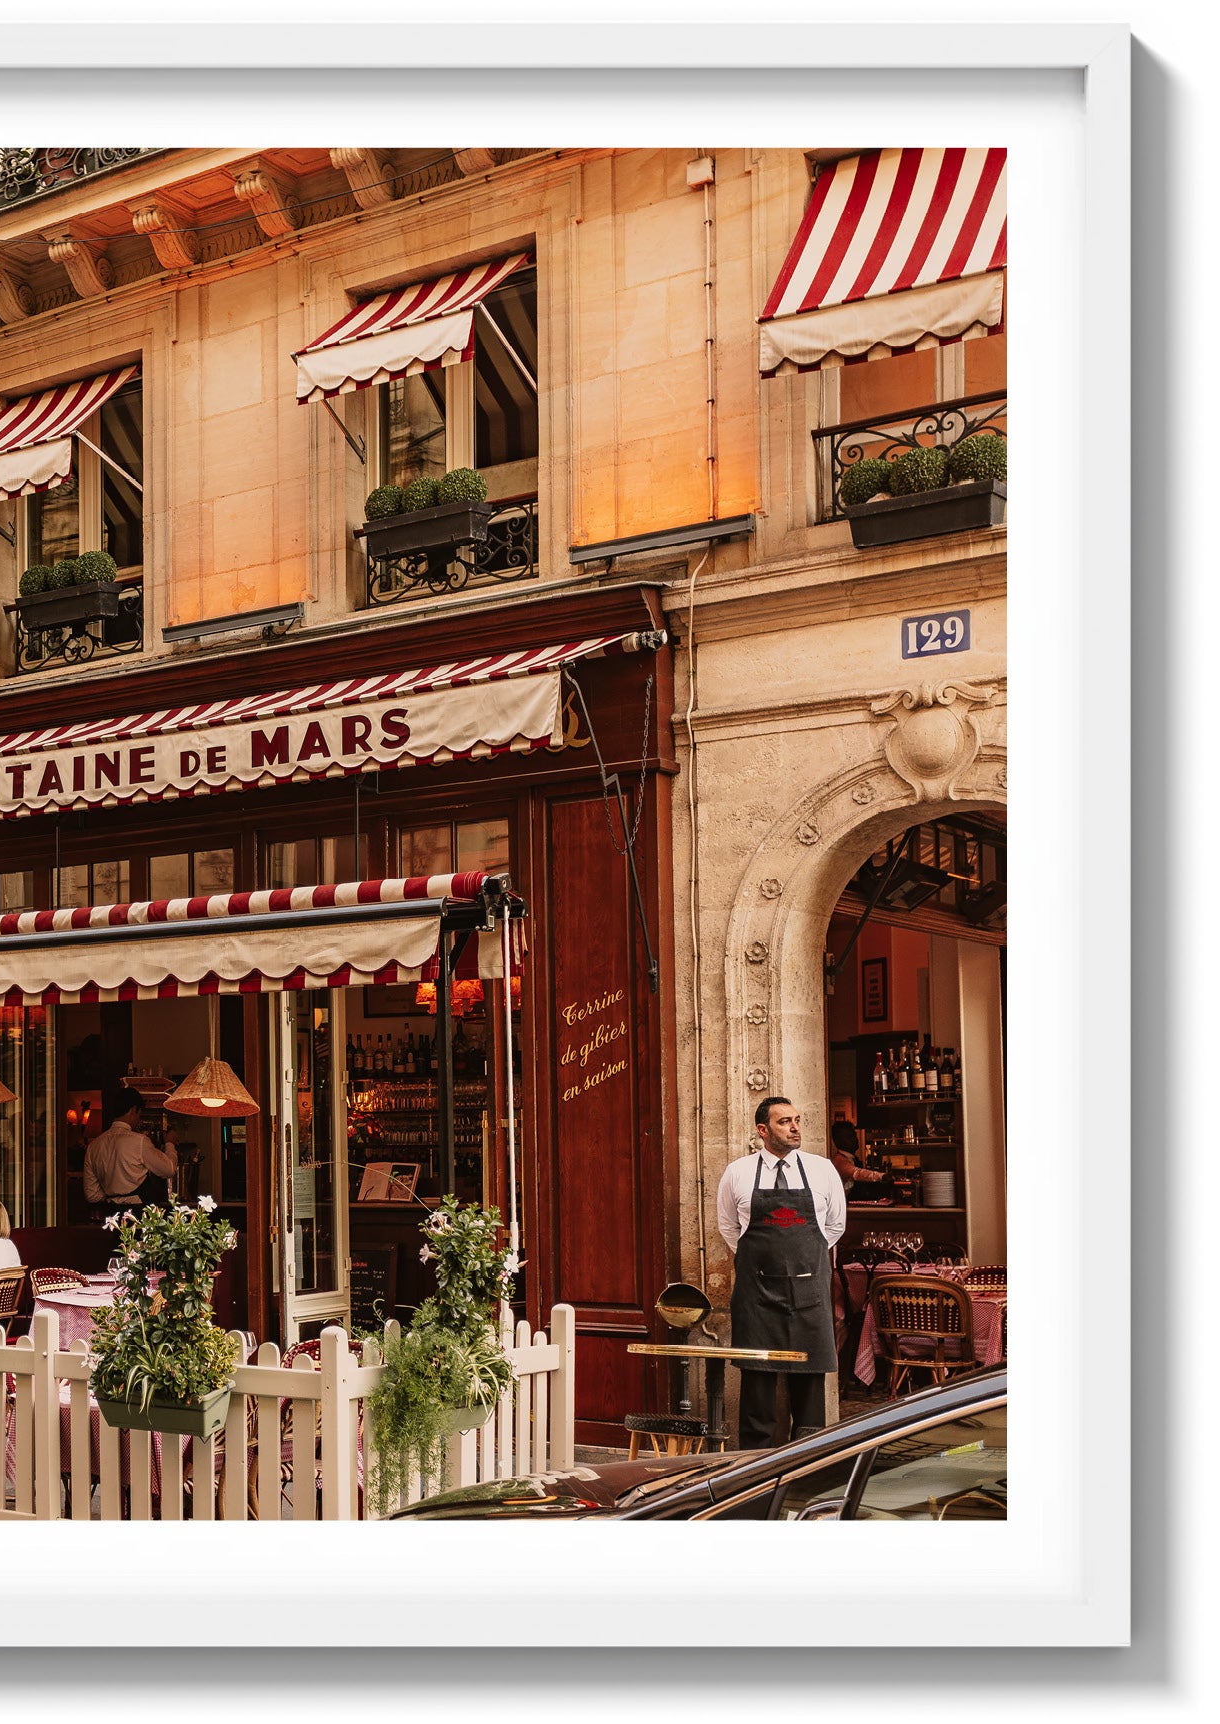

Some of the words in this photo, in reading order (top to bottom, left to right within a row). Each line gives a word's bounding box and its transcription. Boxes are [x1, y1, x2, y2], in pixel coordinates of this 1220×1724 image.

[907, 616, 964, 654] 129
[180, 745, 226, 778] DE
[250, 708, 411, 768] MARS
[561, 989, 625, 1026] Terrine
[560, 1044, 578, 1066] de
[579, 1020, 628, 1068] gibier
[561, 1085, 582, 1102] en
[583, 1059, 628, 1091] saison
